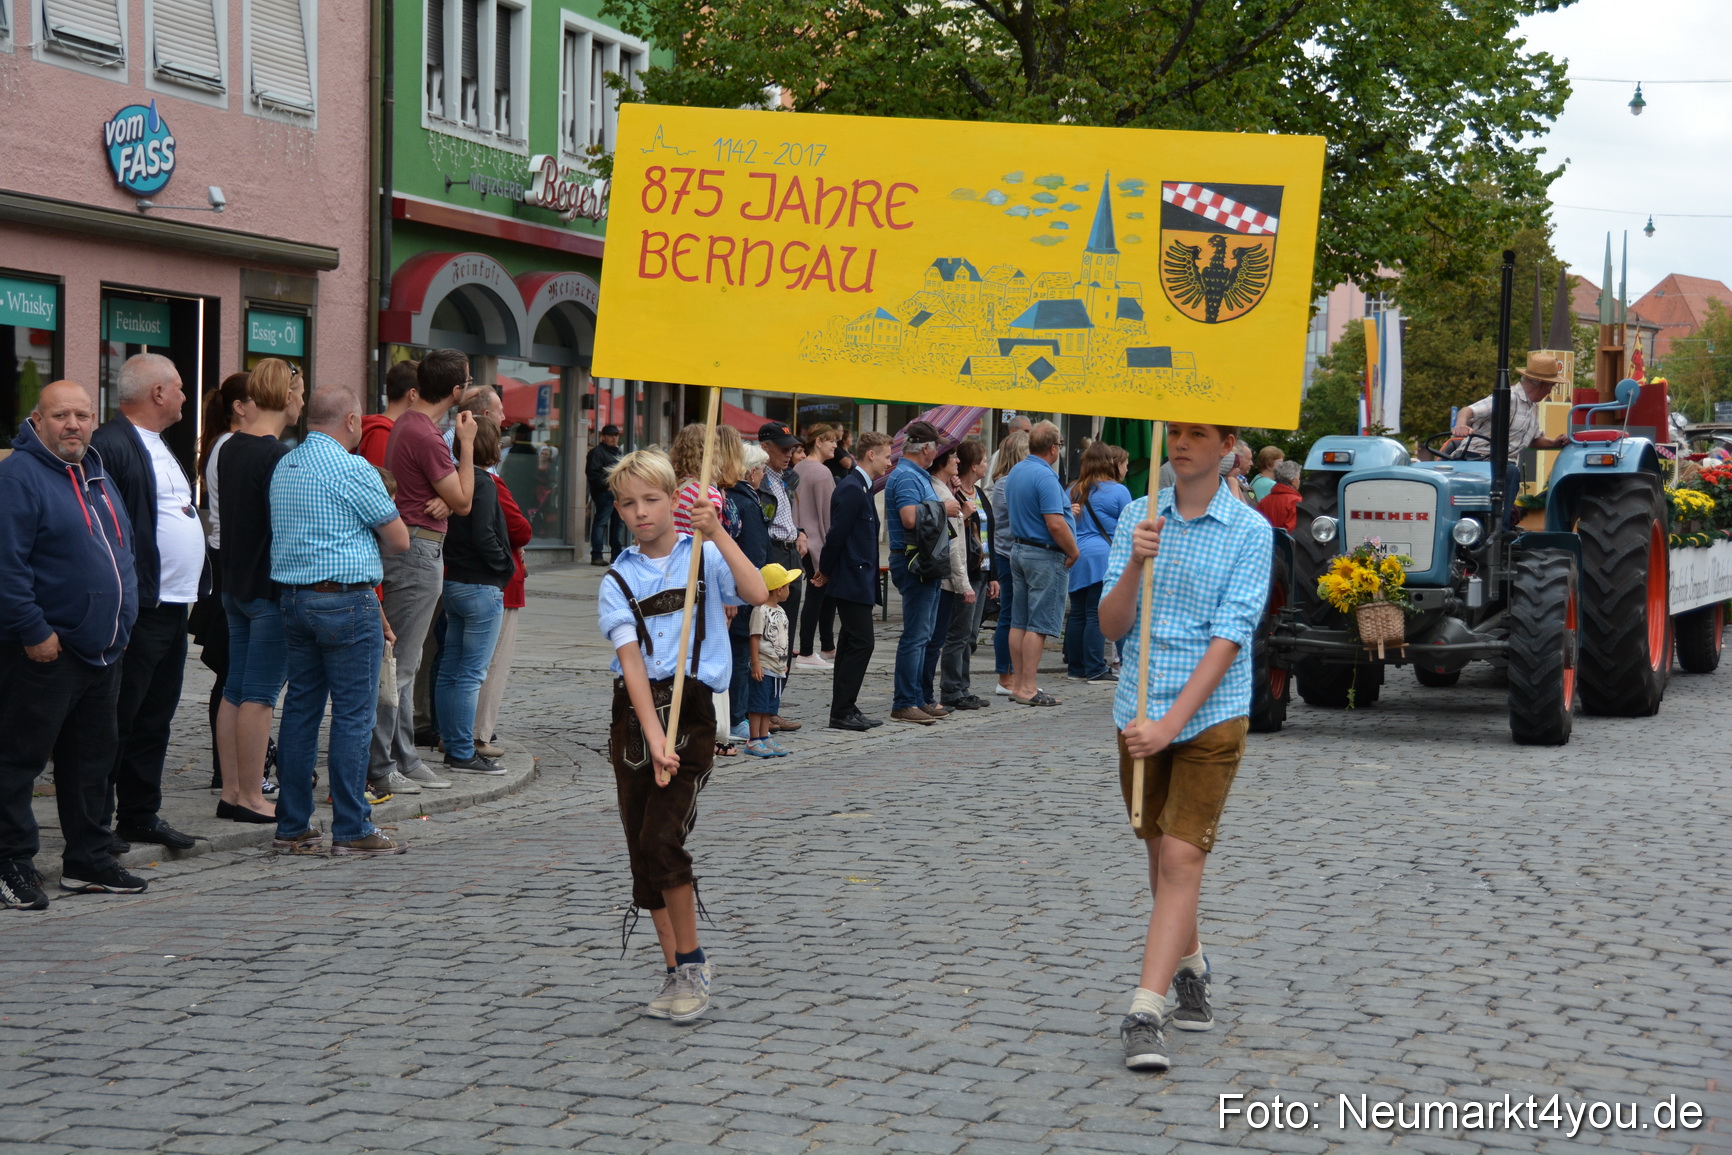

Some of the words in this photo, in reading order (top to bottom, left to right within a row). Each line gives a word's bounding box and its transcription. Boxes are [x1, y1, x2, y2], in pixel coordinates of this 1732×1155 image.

[105, 113, 144, 147] vom
[118, 135, 175, 183] FASS
[469, 172, 525, 203] METZGEREI
[641, 165, 726, 218] 875
[739, 172, 920, 231] JAHRE
[638, 229, 878, 294] BERNGAU
[7, 290, 54, 322] Whisky
[548, 280, 598, 306] Metzgere
[115, 310, 162, 334] Feinkost
[252, 321, 277, 347] Essig
[284, 320, 297, 344] Öl
[1350, 510, 1429, 521] EICHER
